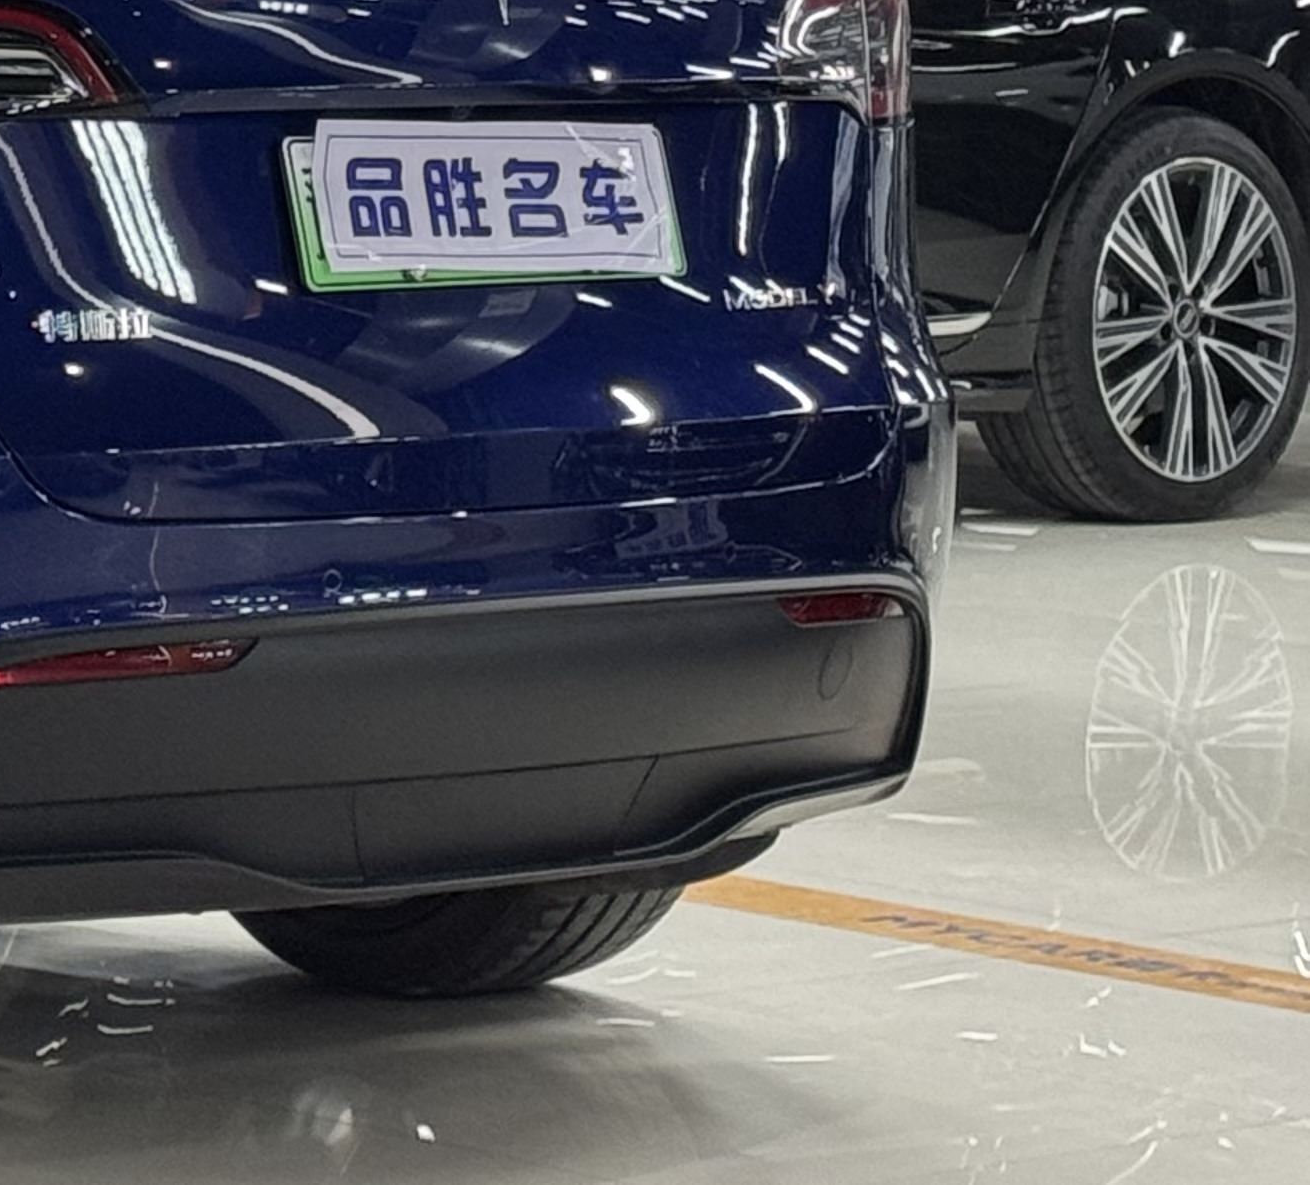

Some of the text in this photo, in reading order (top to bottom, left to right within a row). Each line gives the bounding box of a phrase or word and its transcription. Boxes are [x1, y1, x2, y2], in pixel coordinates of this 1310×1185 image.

[346, 157, 645, 238] 品胜名车
[38, 308, 153, 342] 特斯拉
